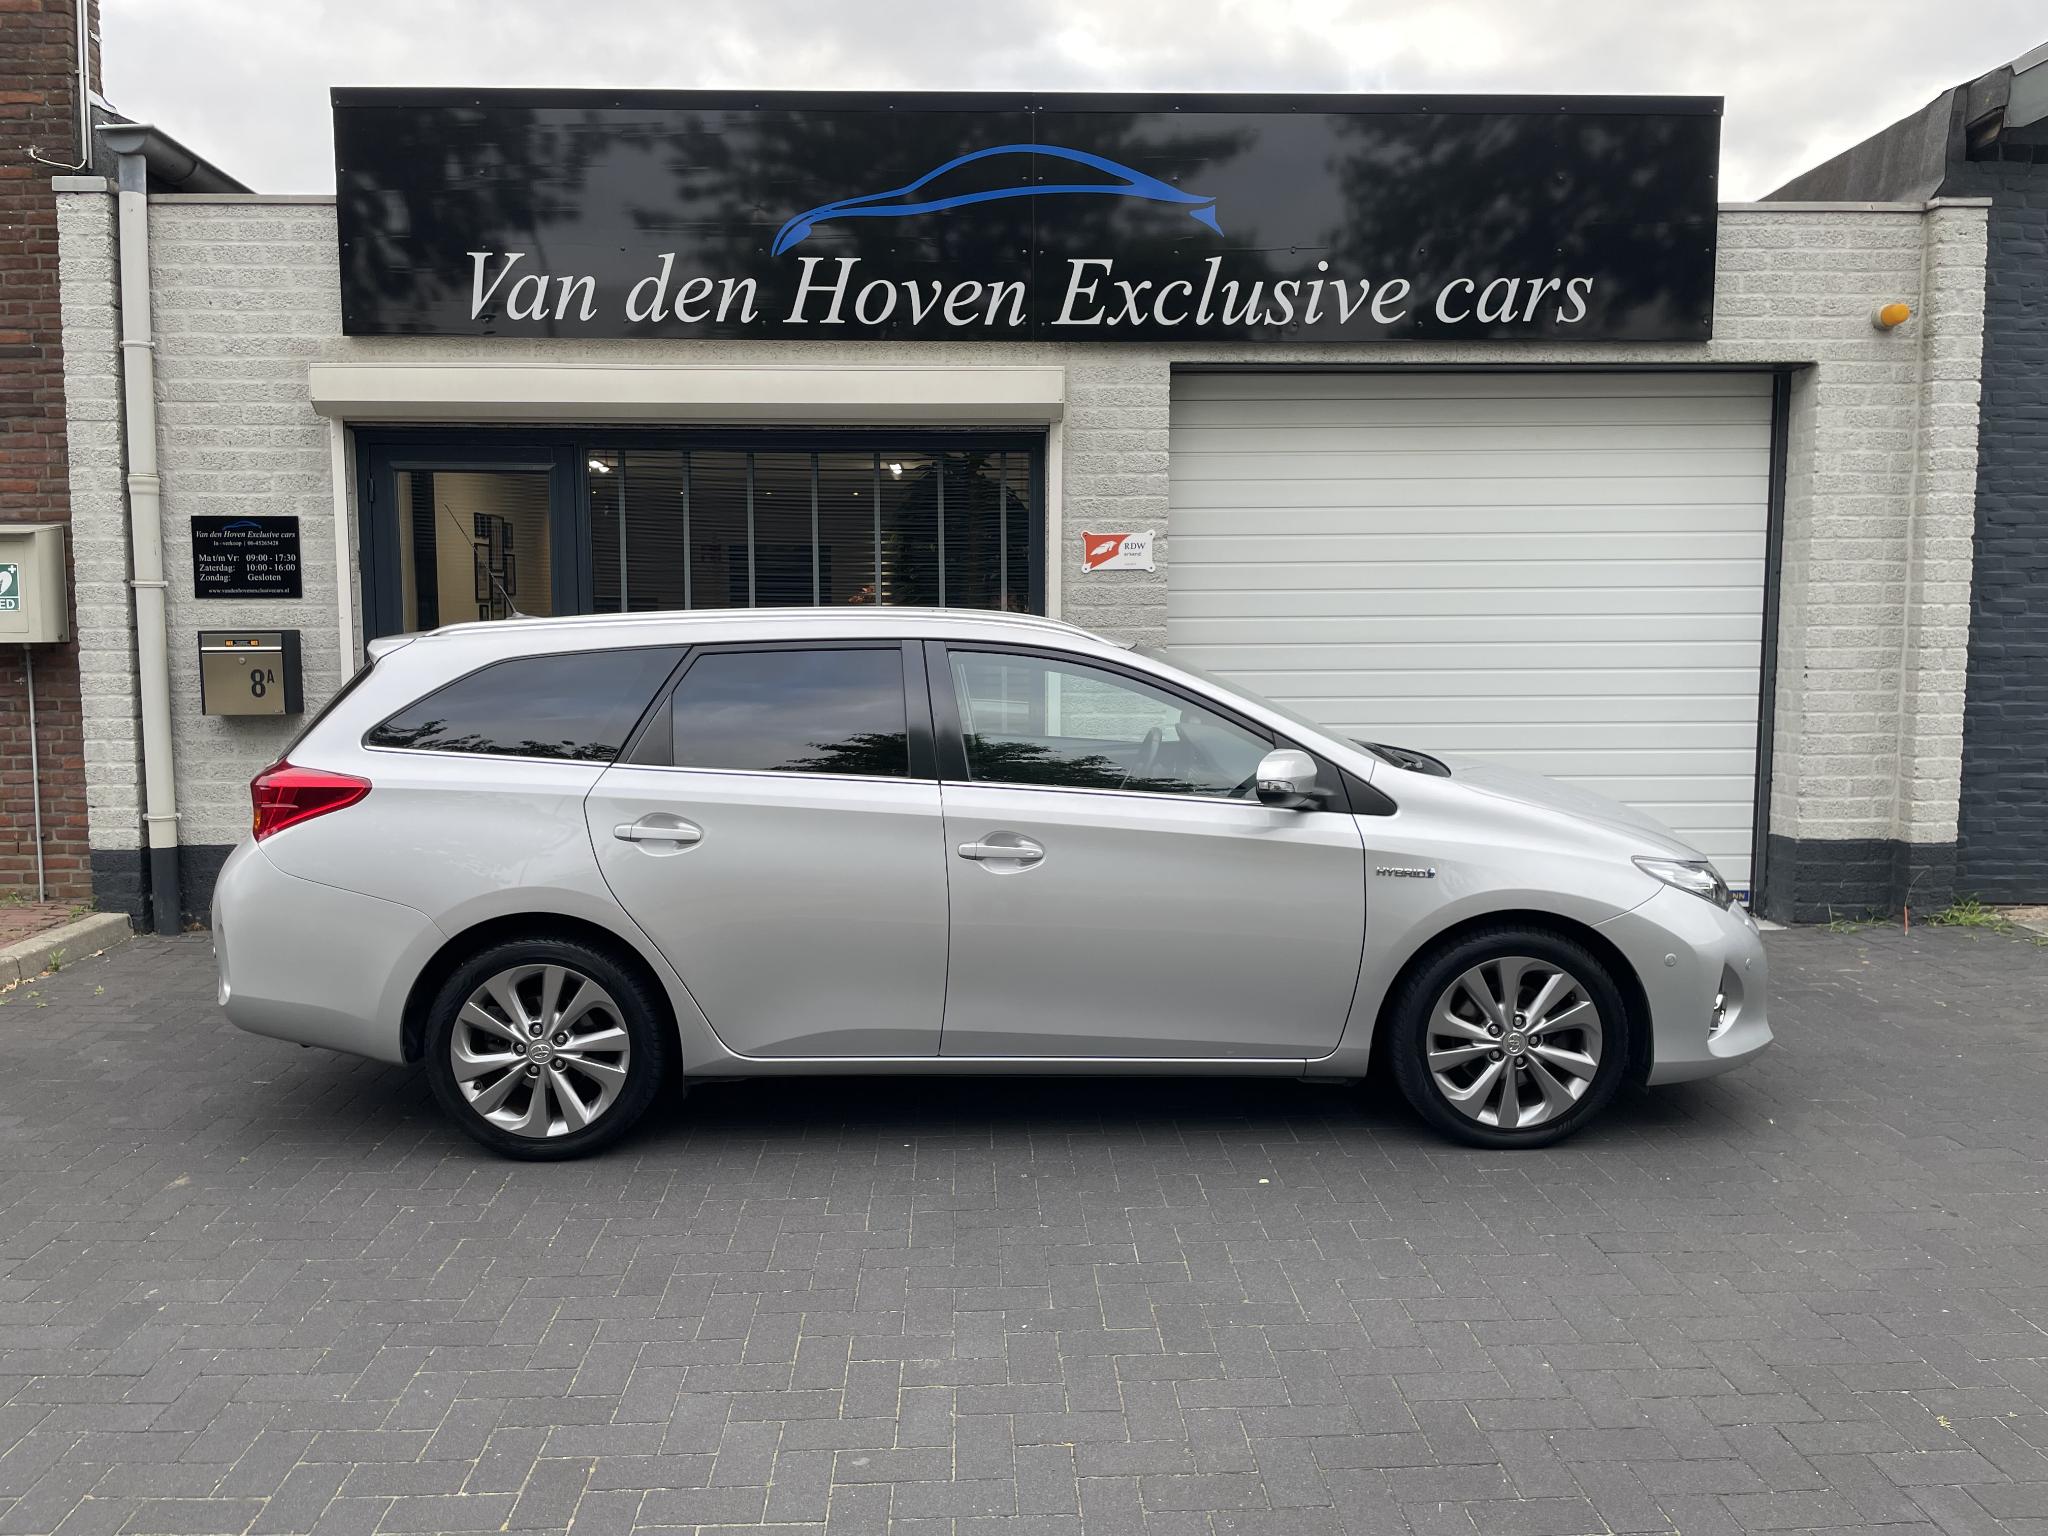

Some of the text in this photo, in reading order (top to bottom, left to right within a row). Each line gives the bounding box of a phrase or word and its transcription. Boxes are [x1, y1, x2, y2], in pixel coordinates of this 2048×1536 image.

[466, 252, 1594, 326] Van den Hoven Exclusive cars
[196, 530, 209, 538] Van
[209, 530, 222, 538] den
[223, 530, 246, 538] Hoven
[247, 530, 280, 538] Exclusive
[1124, 542, 1146, 550] RDW
[199, 554, 212, 562] Ma
[212, 554, 226, 562] t/m
[227, 554, 240, 562] Vr:
[245, 554, 268, 562] 09:00
[274, 554, 297, 562] 17:30
[199, 563, 236, 574] Zaterdag:
[246, 563, 268, 572] 10:00
[274, 563, 296, 572] 16:00
[199, 573, 282, 583] Zondag: Gesloten
[0, 599, 15, 609] ED
[1376, 866, 1426, 878] HYBRID
